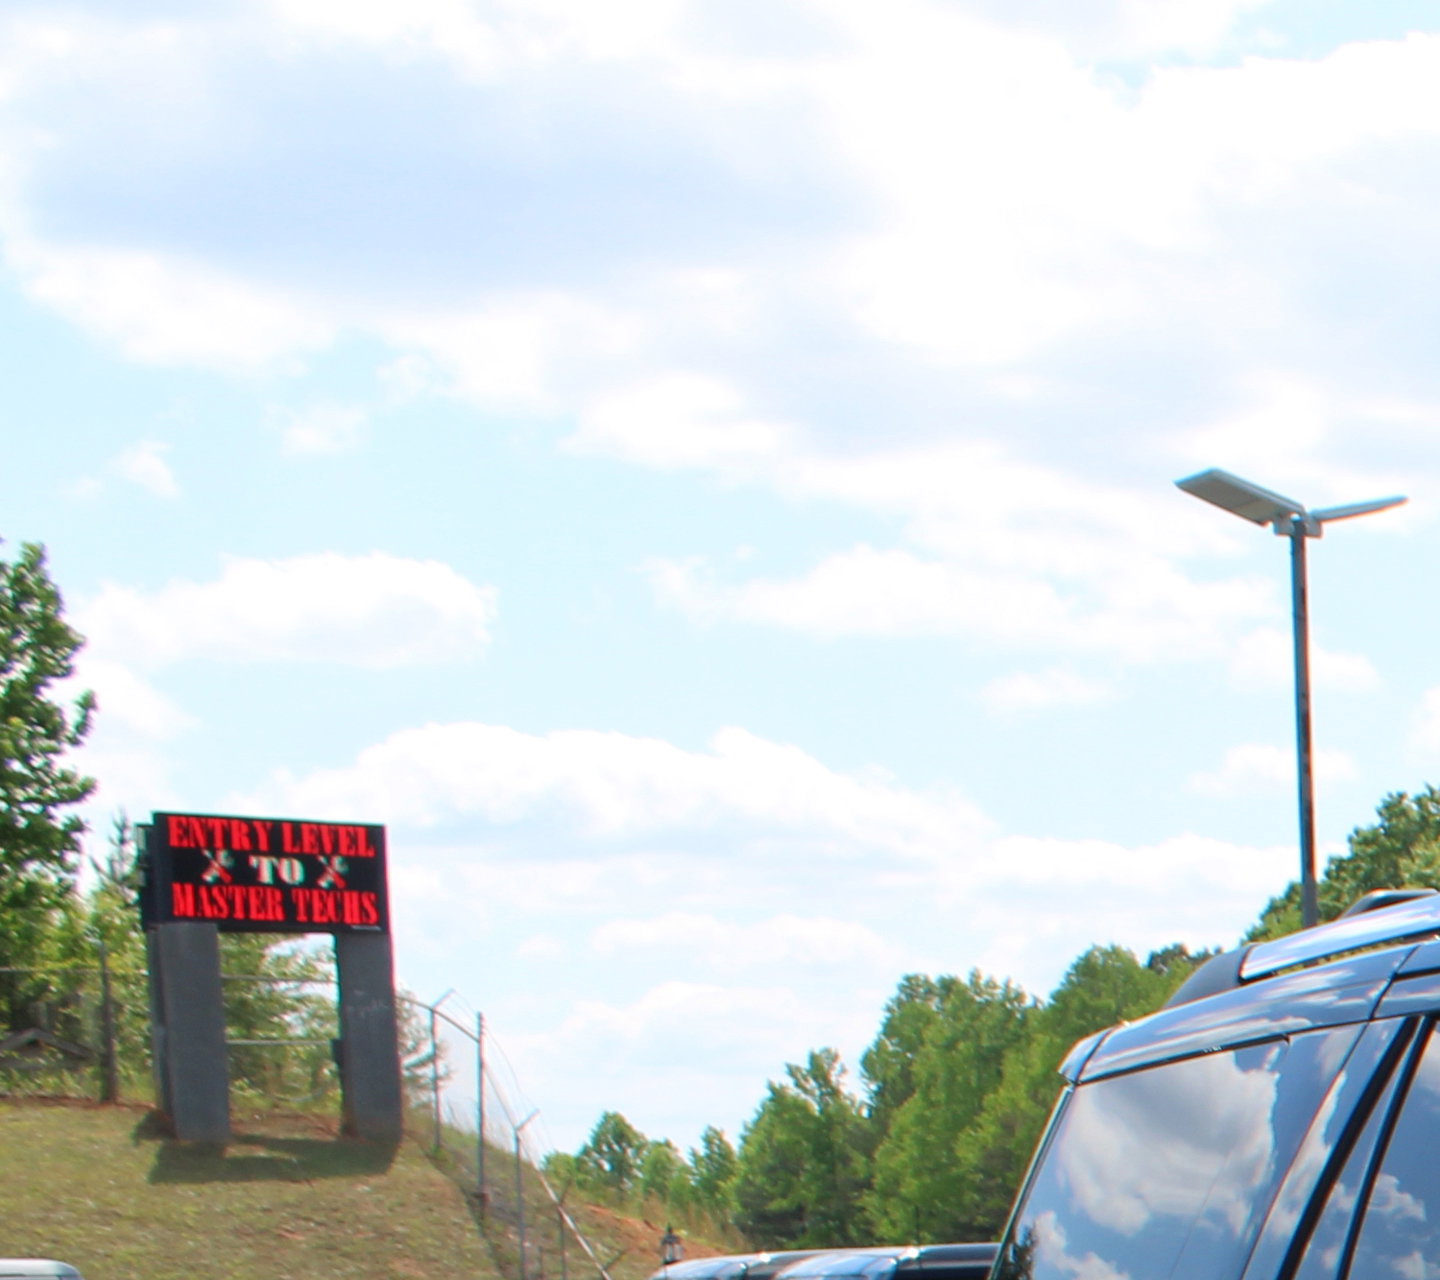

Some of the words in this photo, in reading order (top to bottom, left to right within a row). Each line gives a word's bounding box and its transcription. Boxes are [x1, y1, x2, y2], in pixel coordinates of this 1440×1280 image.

[168, 816, 273, 852] ENTRY
[282, 821, 376, 857] LEVEL
[249, 855, 305, 885] TO
[172, 882, 286, 921] MASTER
[291, 888, 379, 925] TECHS
